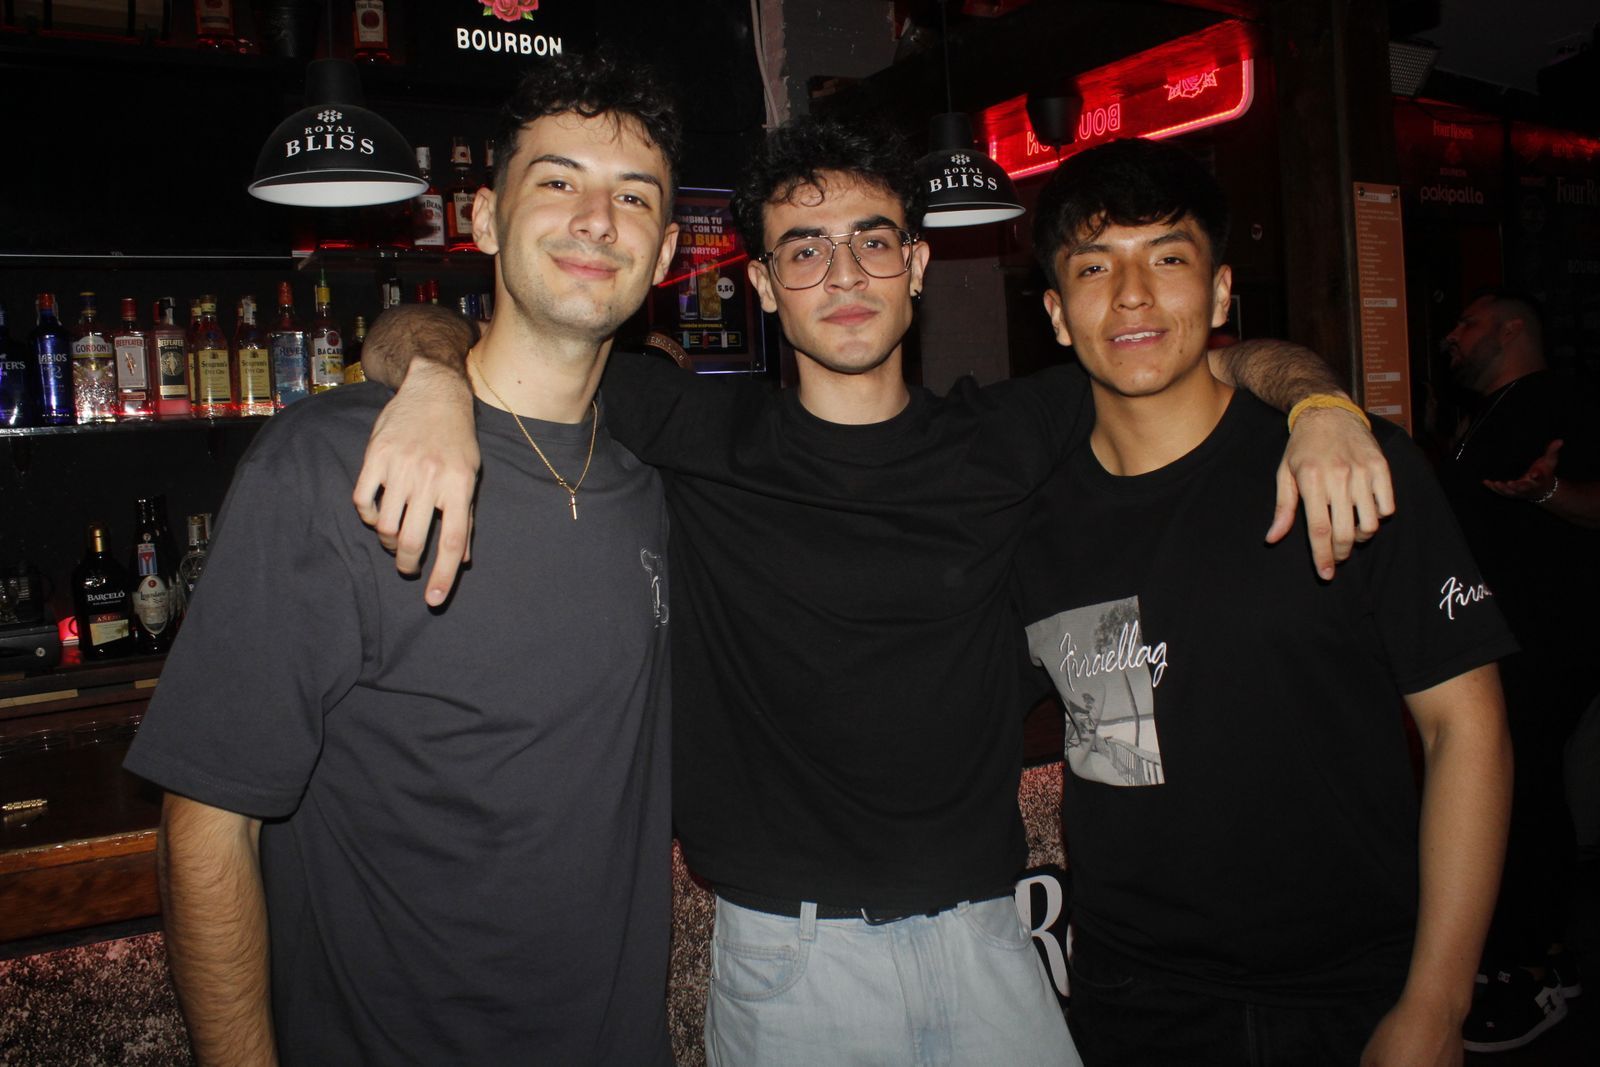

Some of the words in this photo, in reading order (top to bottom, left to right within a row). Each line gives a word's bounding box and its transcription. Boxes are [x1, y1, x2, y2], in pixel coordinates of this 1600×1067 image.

[456, 27, 562, 57] BOURBON
[304, 125, 355, 135] ROYAL
[285, 133, 375, 158] BLISS
[943, 167, 983, 175] ROYAL
[929, 174, 998, 193] BLISS
[679, 247, 720, 255] AVORITO!
[88, 589, 125, 601] BARCELÓ
